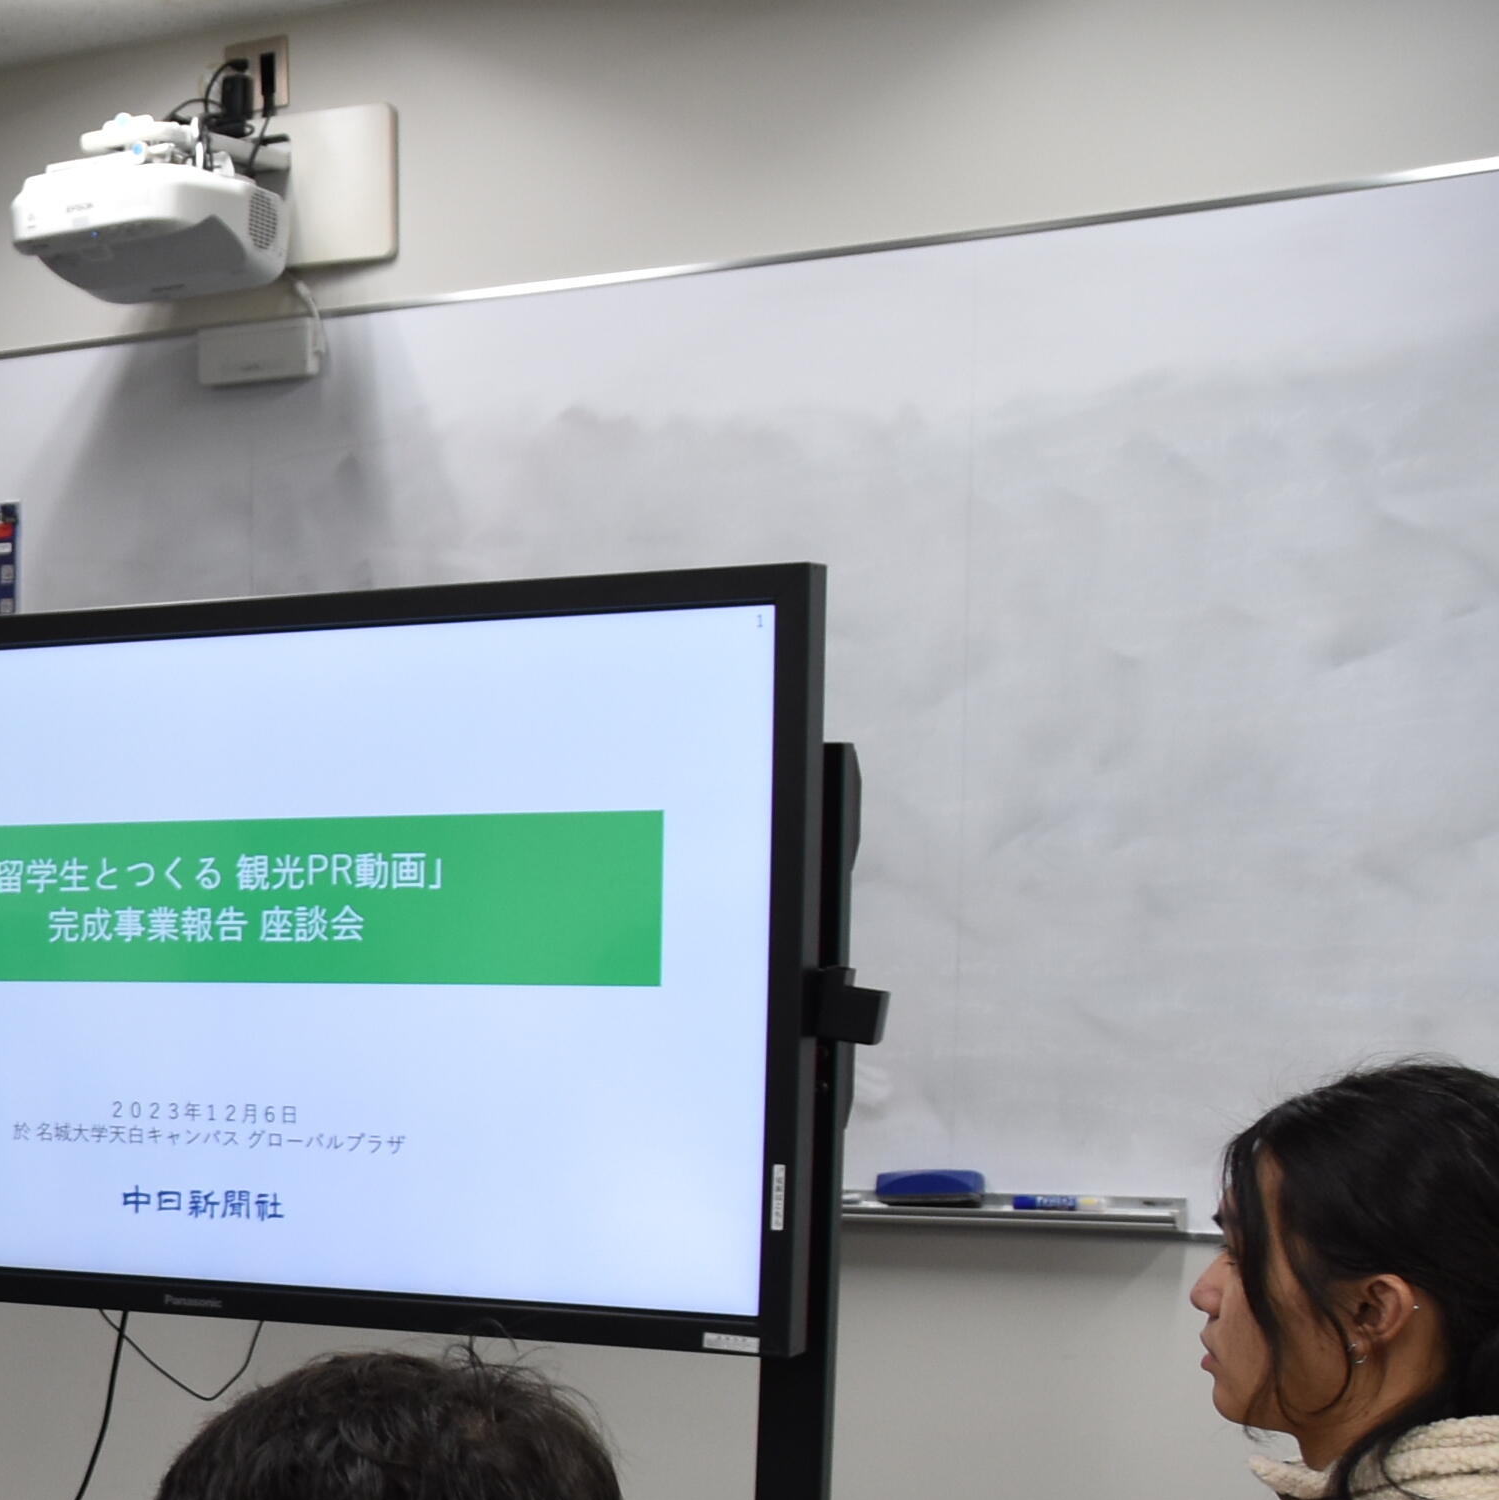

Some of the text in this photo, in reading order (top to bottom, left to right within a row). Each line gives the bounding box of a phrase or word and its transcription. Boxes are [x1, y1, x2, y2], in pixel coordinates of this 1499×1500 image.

[236, 852, 443, 890] 観光PR動画」
[49, 904, 365, 942] 完成事業報告 座談会
[36, 1122, 239, 1147] 名城大学天白キャンパス
[248, 1133, 406, 1155] グローバルプラザ
[121, 1185, 286, 1221] 中日新聞社
